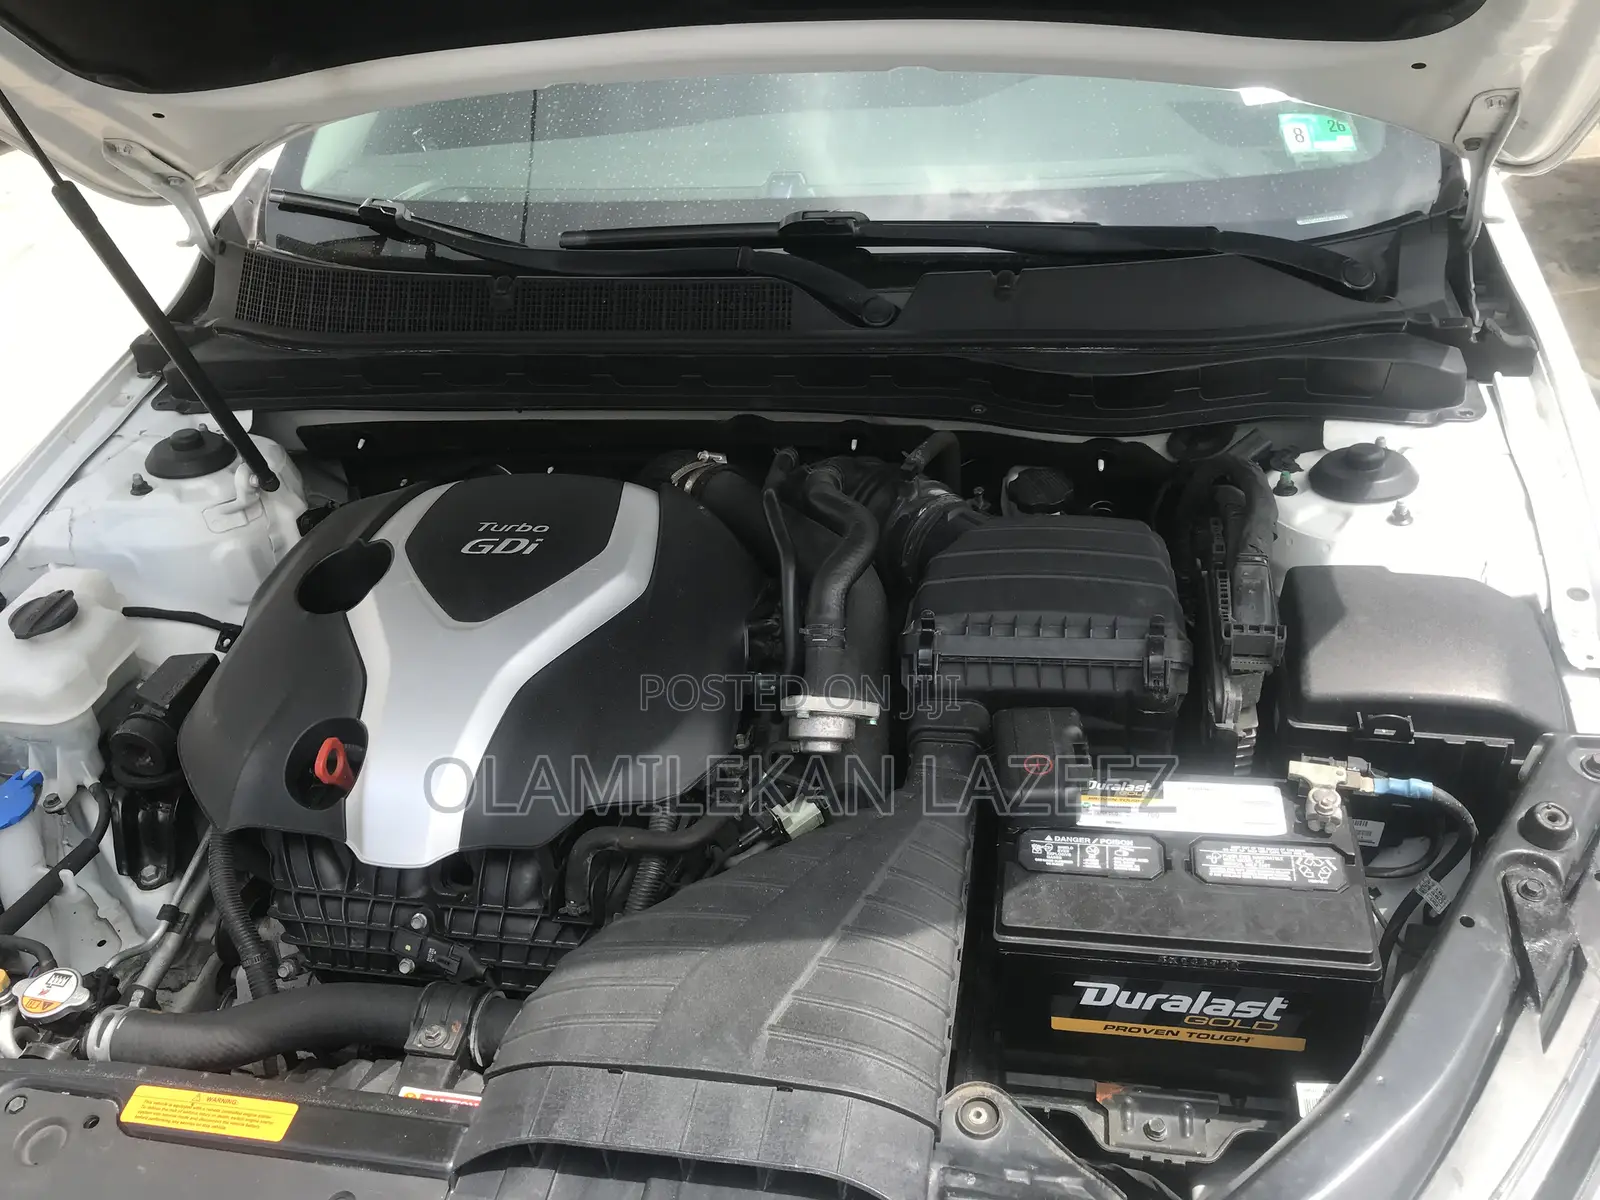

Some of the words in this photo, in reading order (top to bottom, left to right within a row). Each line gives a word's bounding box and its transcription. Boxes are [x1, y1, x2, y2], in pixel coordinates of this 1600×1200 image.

[1327, 119, 1346, 132] 26
[1293, 127, 1305, 143] 8
[478, 522, 550, 533] Turbo
[460, 538, 544, 555] GDi
[1087, 779, 1152, 793] Duralast
[1054, 835, 1091, 844] DANGER
[1100, 838, 1134, 846] POISON
[1073, 981, 1288, 1021] Duralast
[1183, 1015, 1279, 1031] GOLD
[1102, 1024, 1180, 1037] PROVEN
[1186, 1032, 1253, 1044] TOUGH
